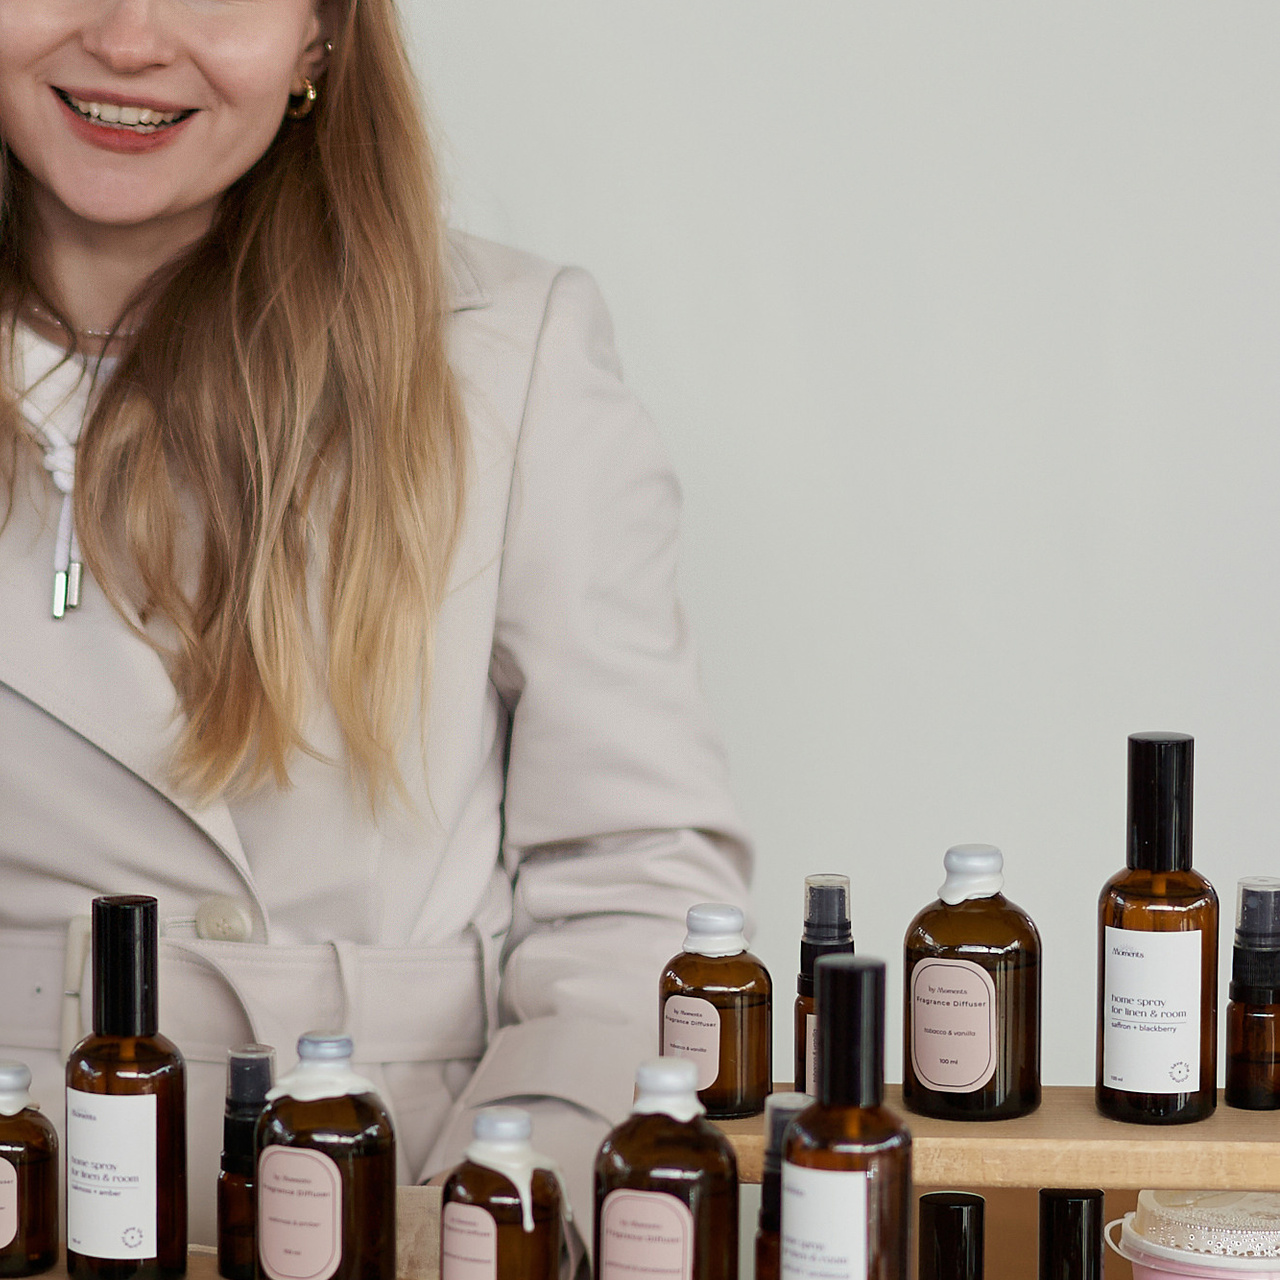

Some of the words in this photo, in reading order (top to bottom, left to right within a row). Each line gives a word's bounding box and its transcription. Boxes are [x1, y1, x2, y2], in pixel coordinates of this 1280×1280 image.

[928, 986, 936, 995] by
[916, 996, 951, 1008] Fragrance
[953, 1000, 986, 1008] Diffuser
[1111, 994, 1135, 1005] home
[1137, 997, 1166, 1008] spray
[1111, 1005, 1122, 1015] for
[1124, 1007, 1148, 1018] linen
[1149, 1009, 1158, 1019] &
[1160, 1010, 1187, 1018] room
[665, 1014, 689, 1025] Fragrance
[690, 1020, 717, 1028] Diffuser
[1111, 1021, 1132, 1031] saffron
[1139, 1024, 1177, 1033] blackberry
[923, 1027, 947, 1036] tobacco
[112, 1175, 140, 1183] room
